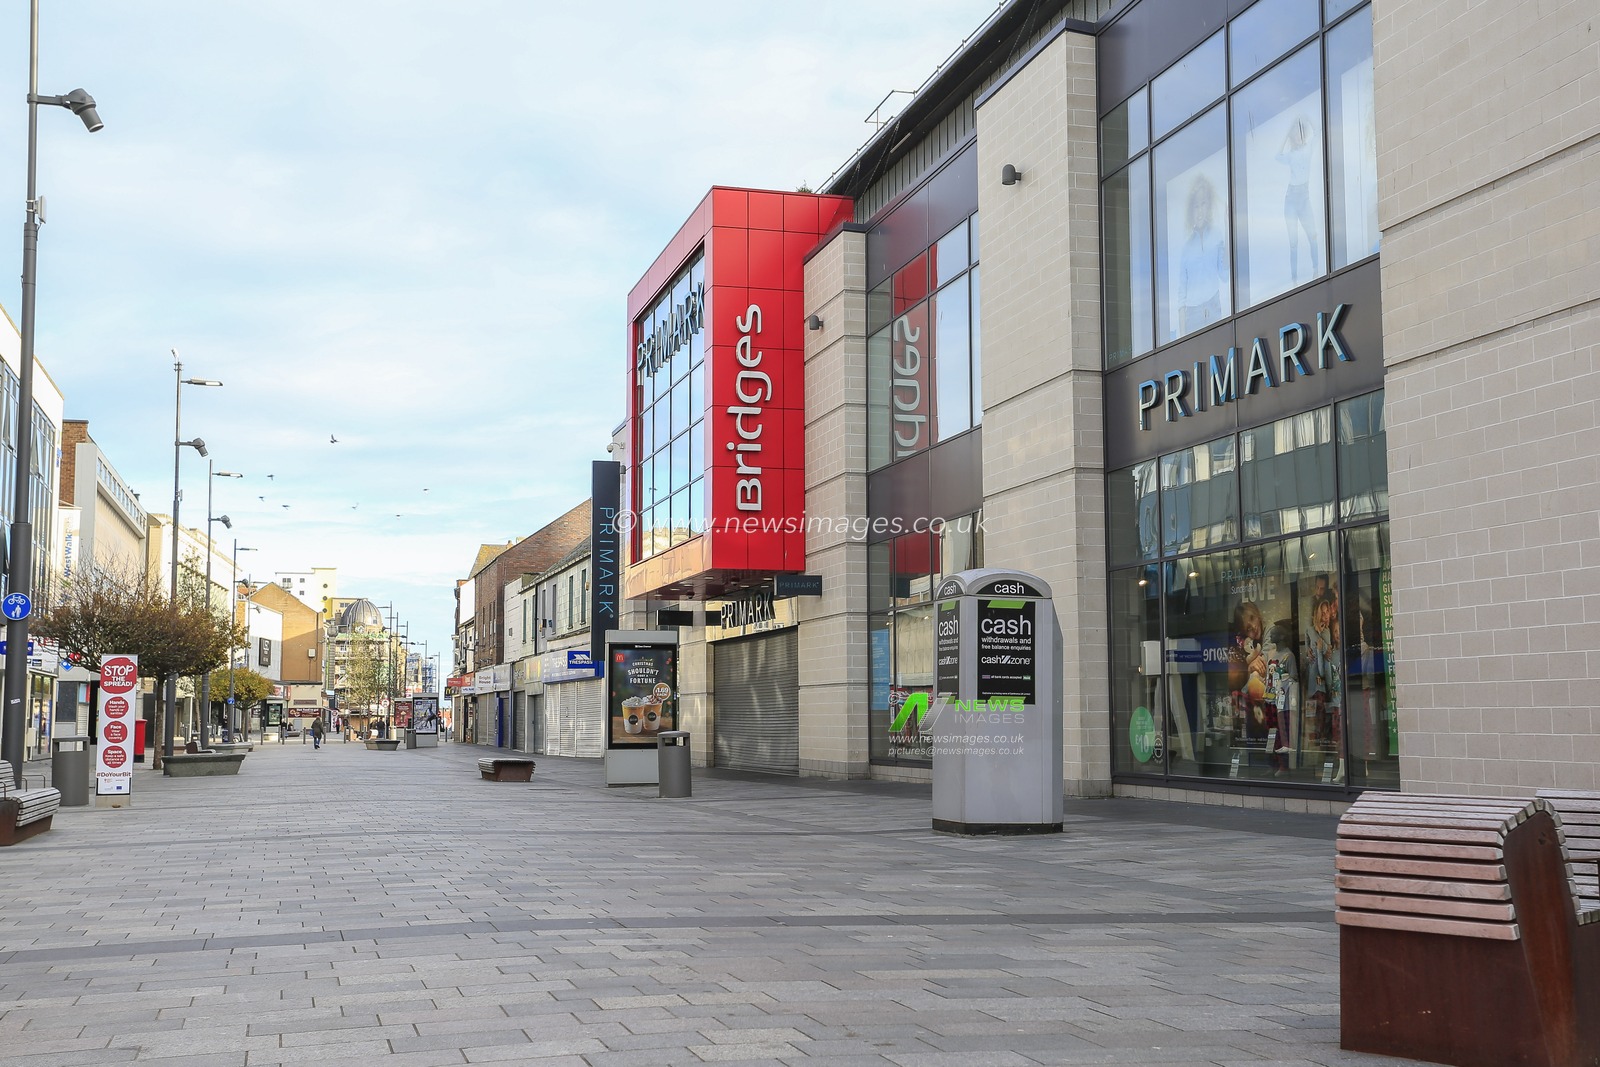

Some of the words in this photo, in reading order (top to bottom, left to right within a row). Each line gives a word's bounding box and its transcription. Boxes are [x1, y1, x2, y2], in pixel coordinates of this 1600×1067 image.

[636, 282, 704, 377] PRIMARK
[1138, 302, 1355, 431] PRIMARK
[727, 303, 772, 511] Bridges
[599, 507, 615, 614] PRIMARK
[779, 581, 817, 589] PRIMARK
[943, 582, 957, 595] cash
[994, 582, 1025, 594] cash
[1241, 576, 1276, 603] LOVE
[721, 592, 772, 629] PRIMARK
[939, 615, 958, 636] cash
[981, 615, 1031, 635] cash
[104, 665, 134, 676] STOP
[628, 668, 659, 676] SHOULDN'T
[1135, 734, 1150, 753] £10
